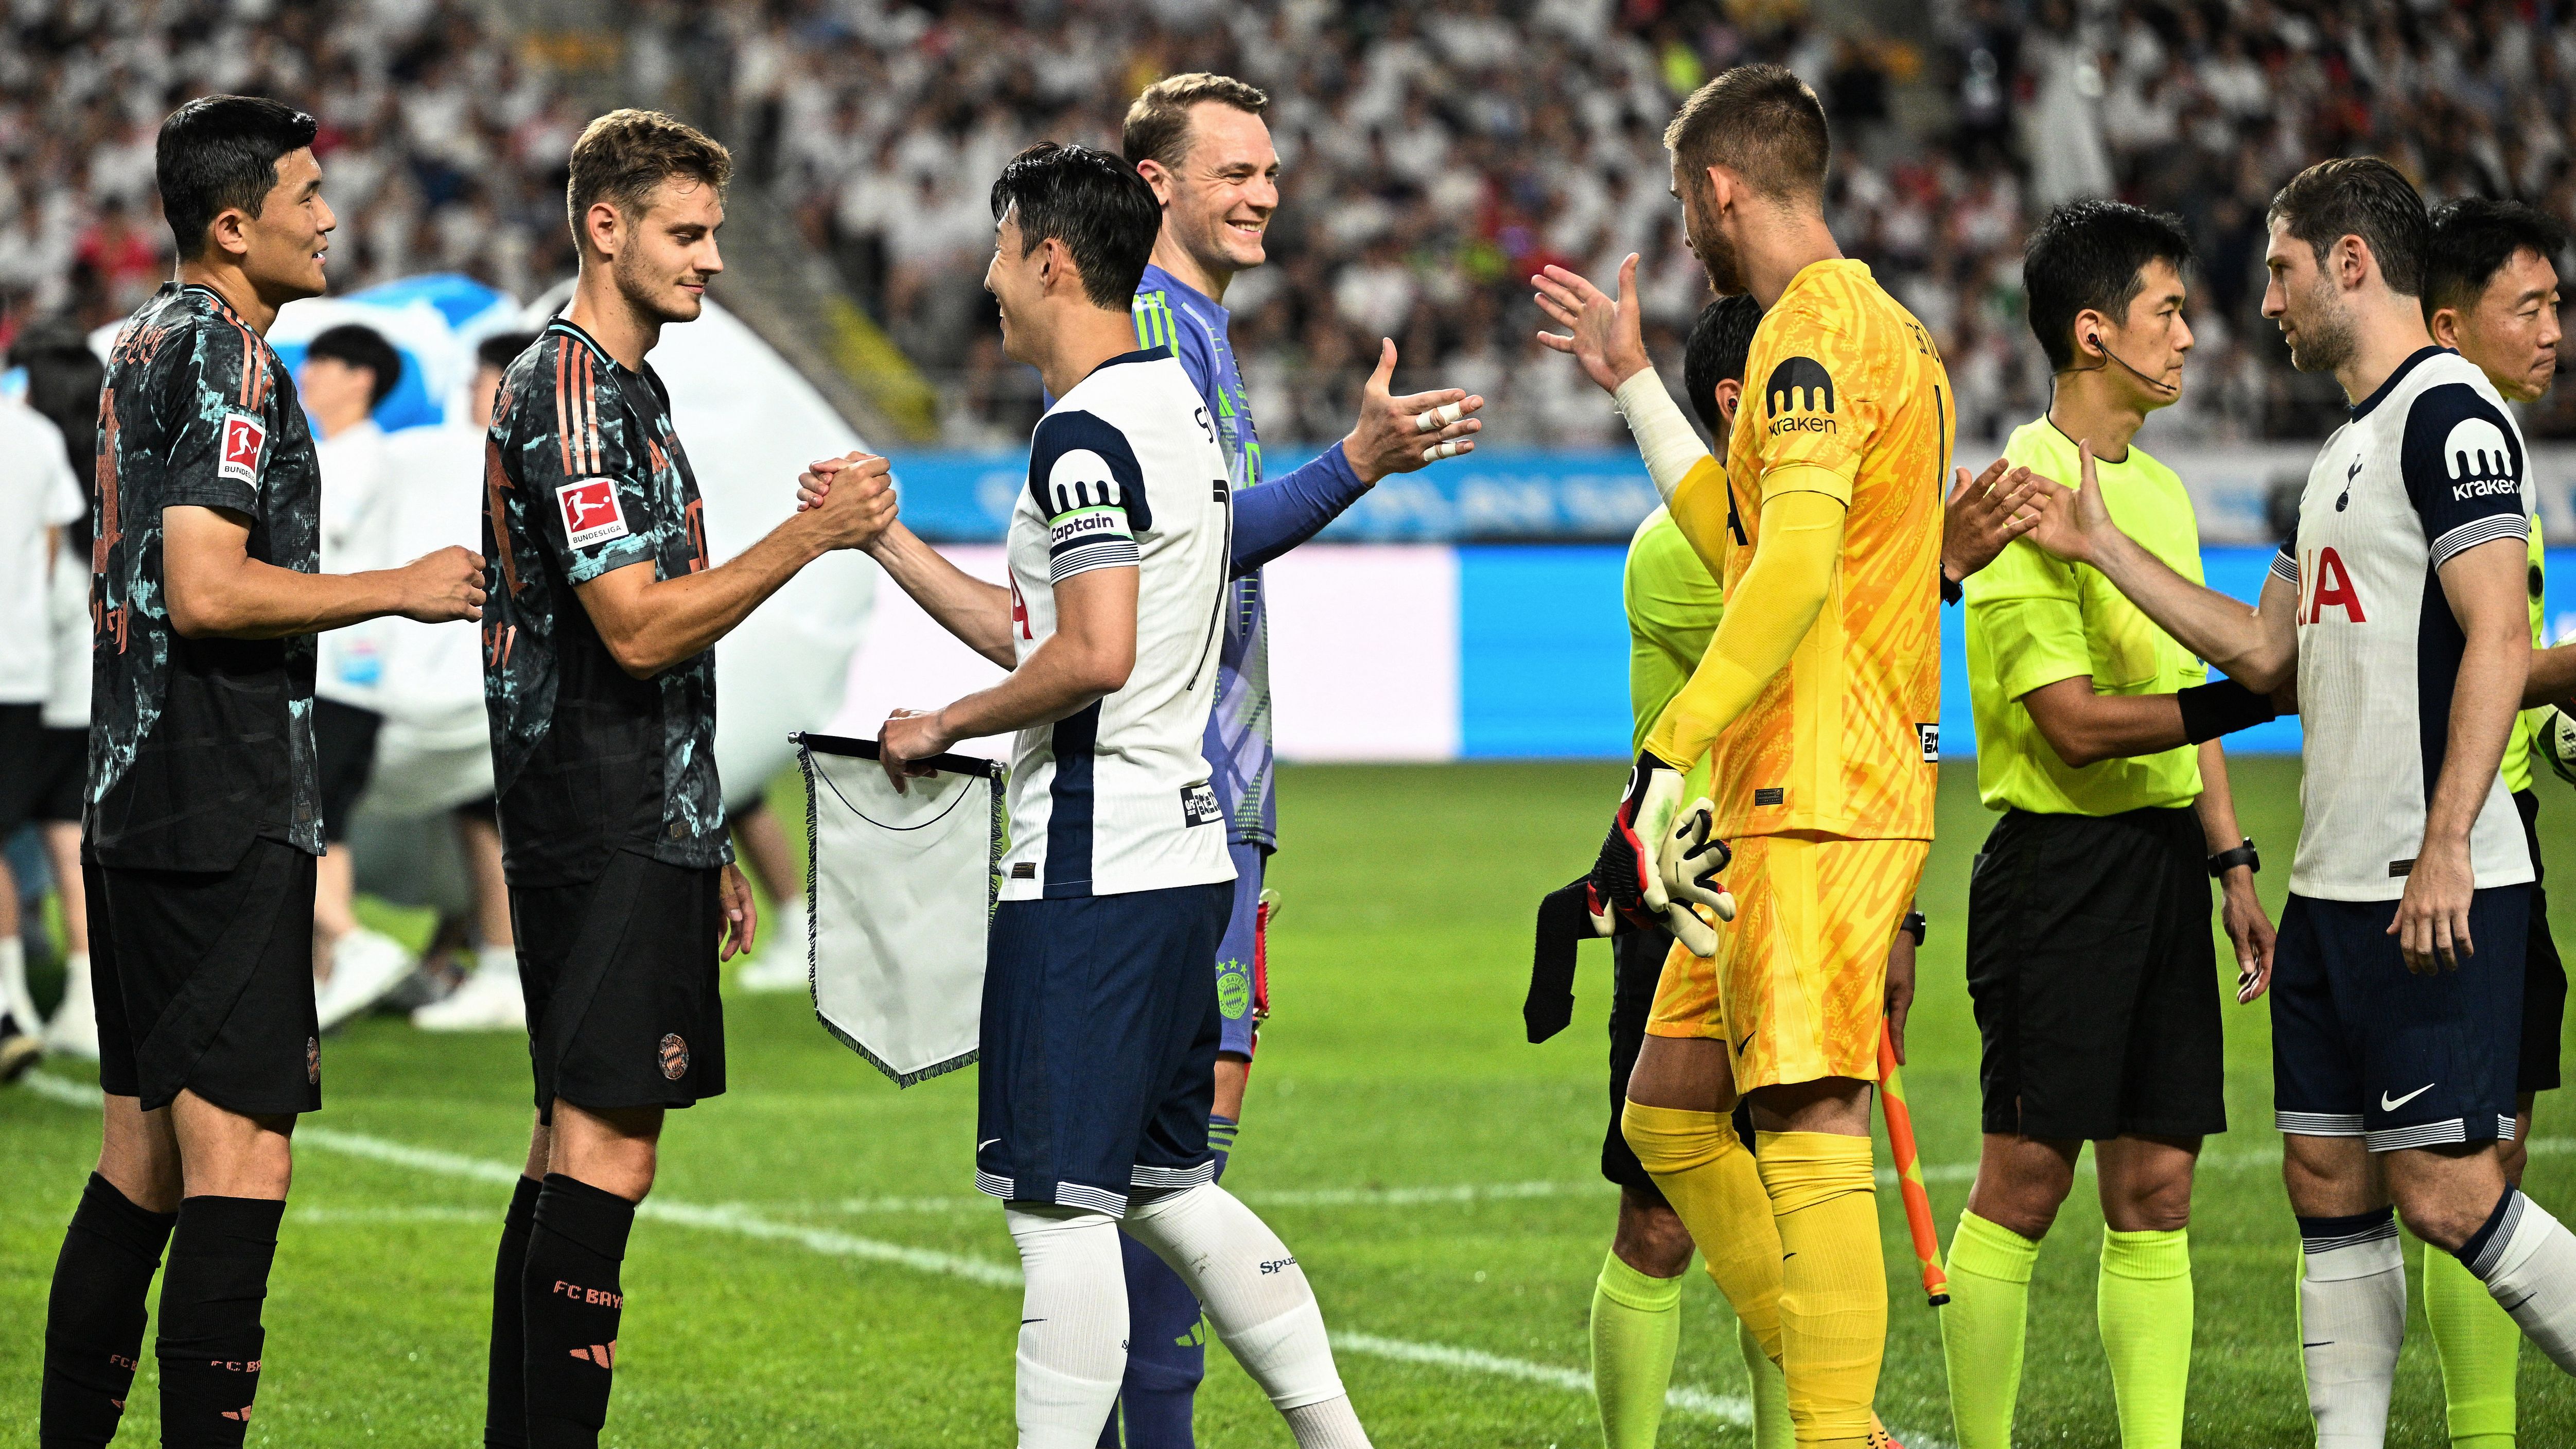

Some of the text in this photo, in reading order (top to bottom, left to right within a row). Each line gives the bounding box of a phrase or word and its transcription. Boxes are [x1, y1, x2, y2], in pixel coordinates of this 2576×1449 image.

[1768, 417, 1836, 439] kraken
[2452, 479, 2519, 501] kraken
[573, 525, 622, 544] BUNDESLIGA
[1187, 480, 1230, 691] 7
[553, 1280, 582, 1299] FC
[110, 1354, 130, 1368] FC
